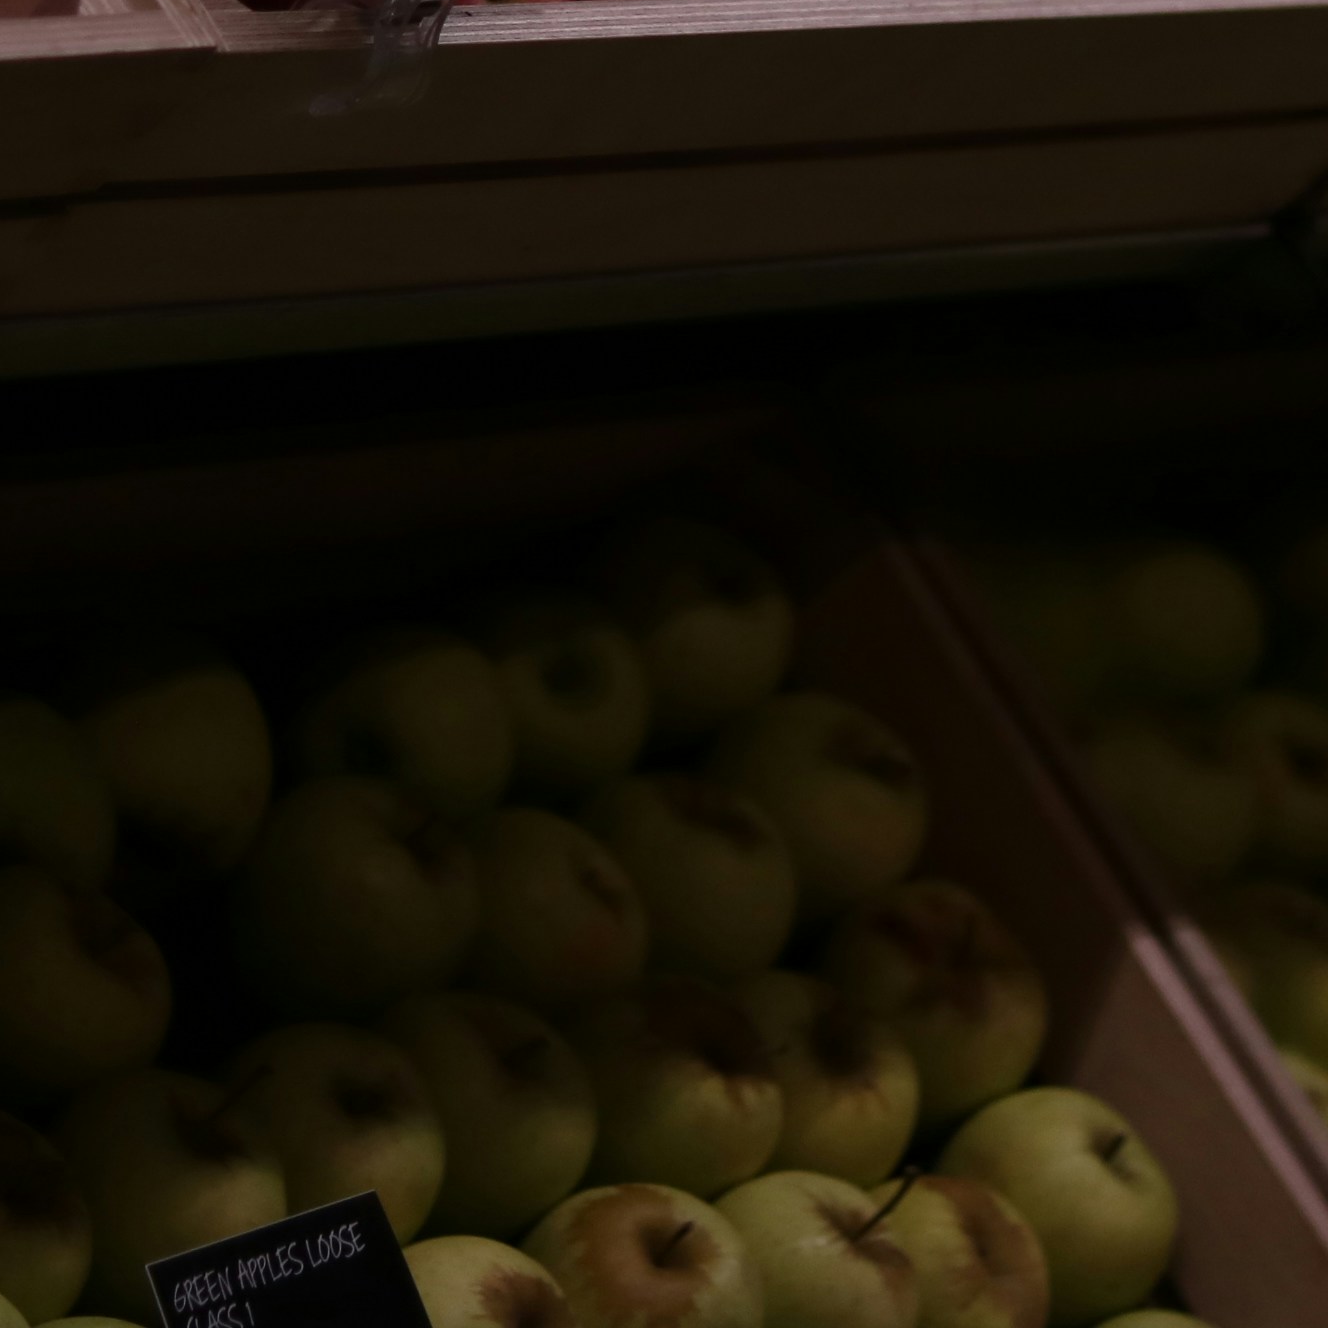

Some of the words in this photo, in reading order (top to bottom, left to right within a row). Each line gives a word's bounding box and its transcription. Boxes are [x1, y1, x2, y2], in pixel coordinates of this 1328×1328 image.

[173, 1266, 234, 1314] GREEN
[237, 1241, 305, 1290] APPLES
[305, 1221, 366, 1268] LOOSE
